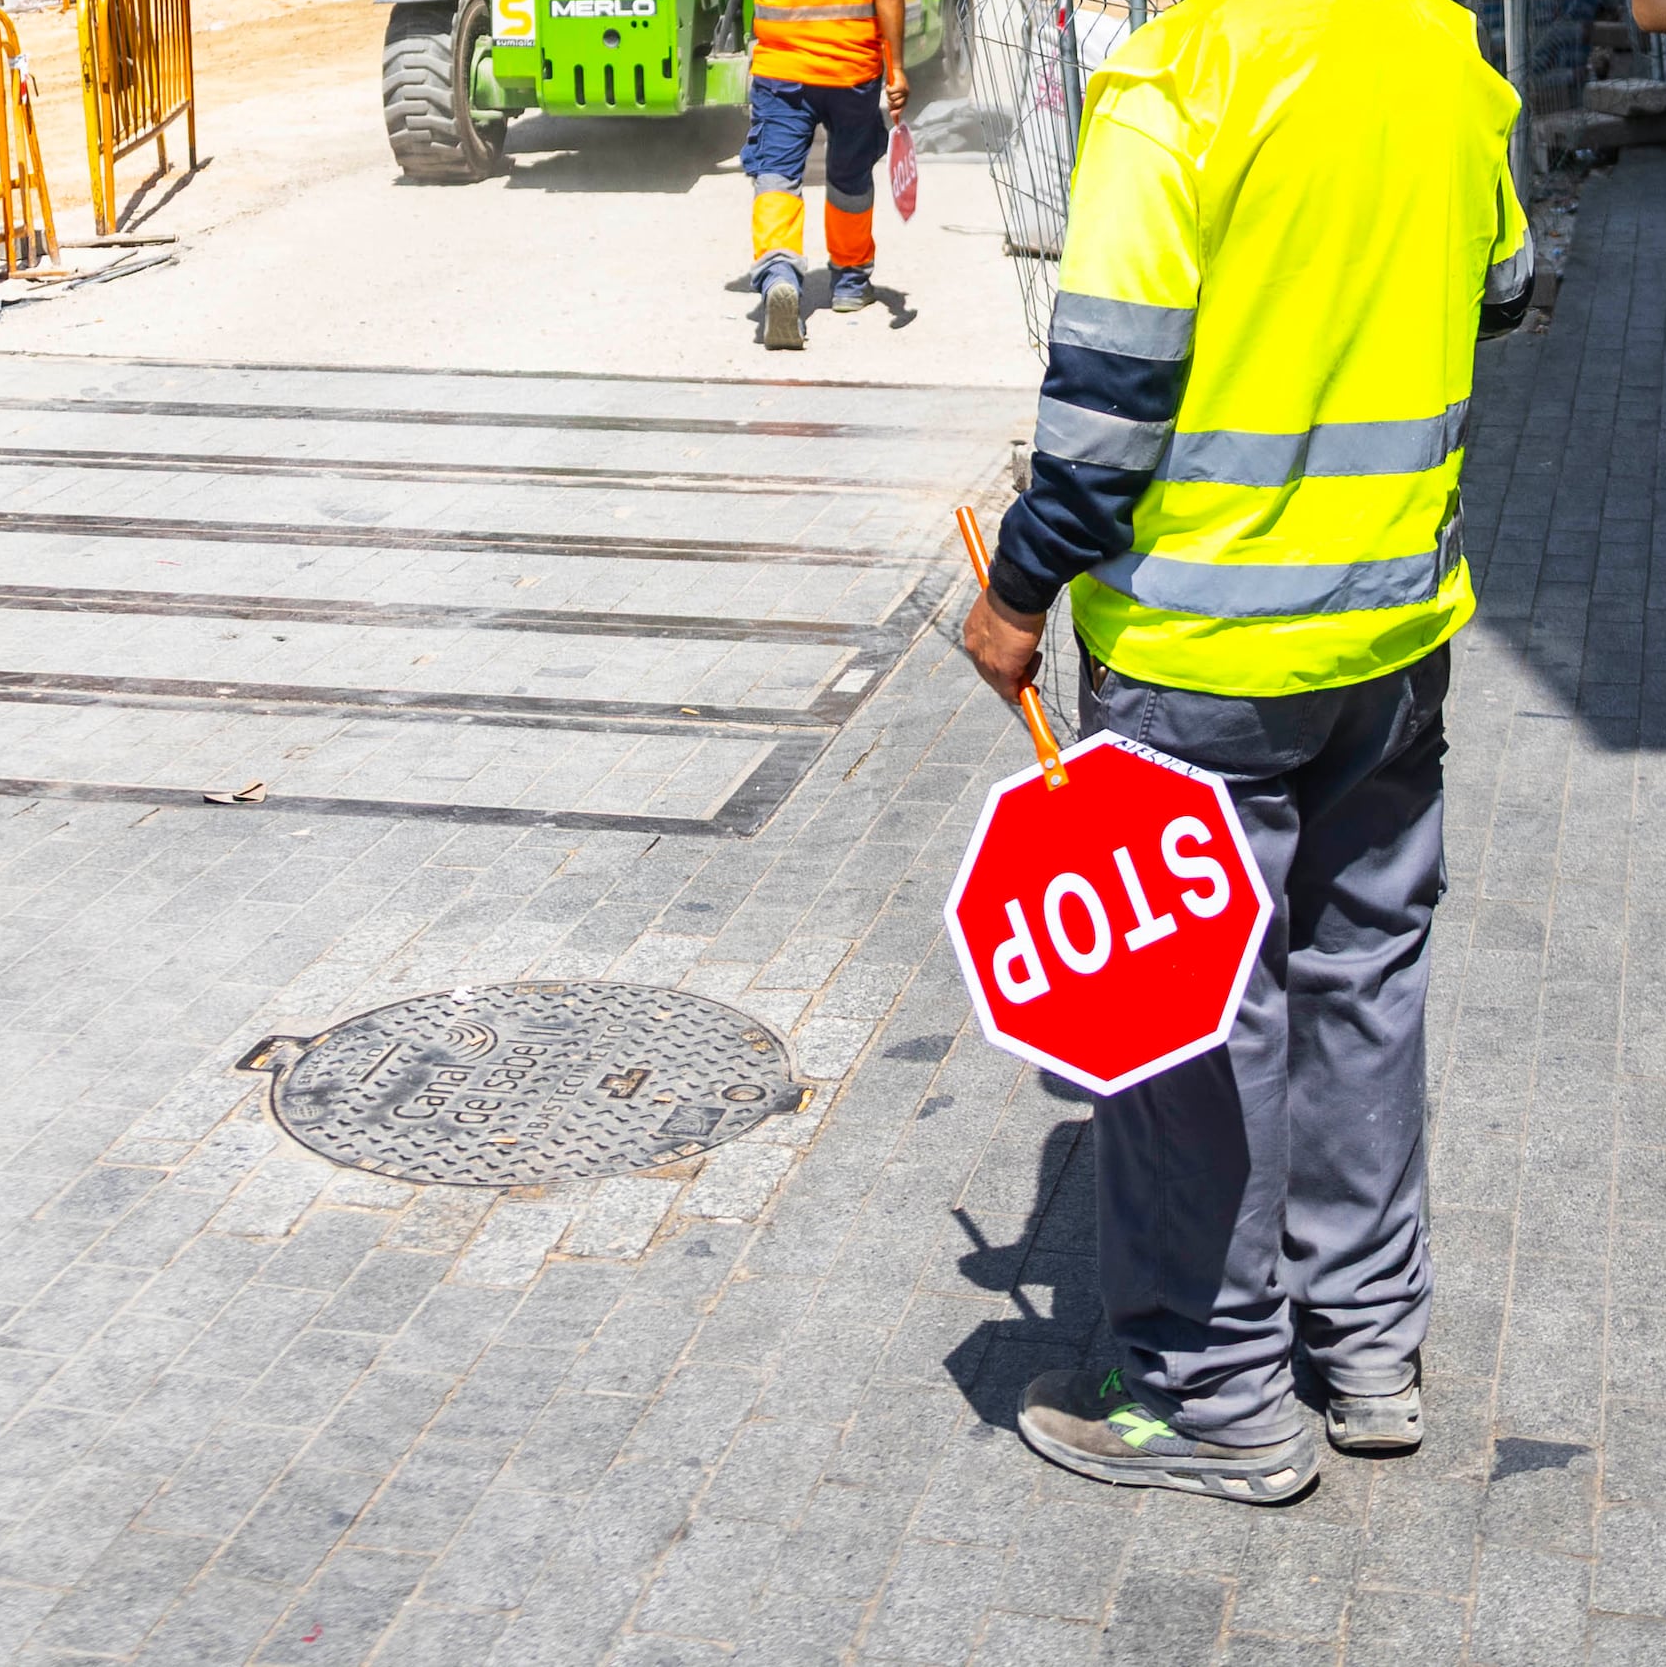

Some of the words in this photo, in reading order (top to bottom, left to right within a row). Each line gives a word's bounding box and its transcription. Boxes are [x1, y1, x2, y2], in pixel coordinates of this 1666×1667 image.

[893, 152, 916, 199] STOP
[992, 815, 1230, 1005] STOP
[392, 1063, 477, 1121] Canal
[468, 1039, 553, 1095] Isabel
